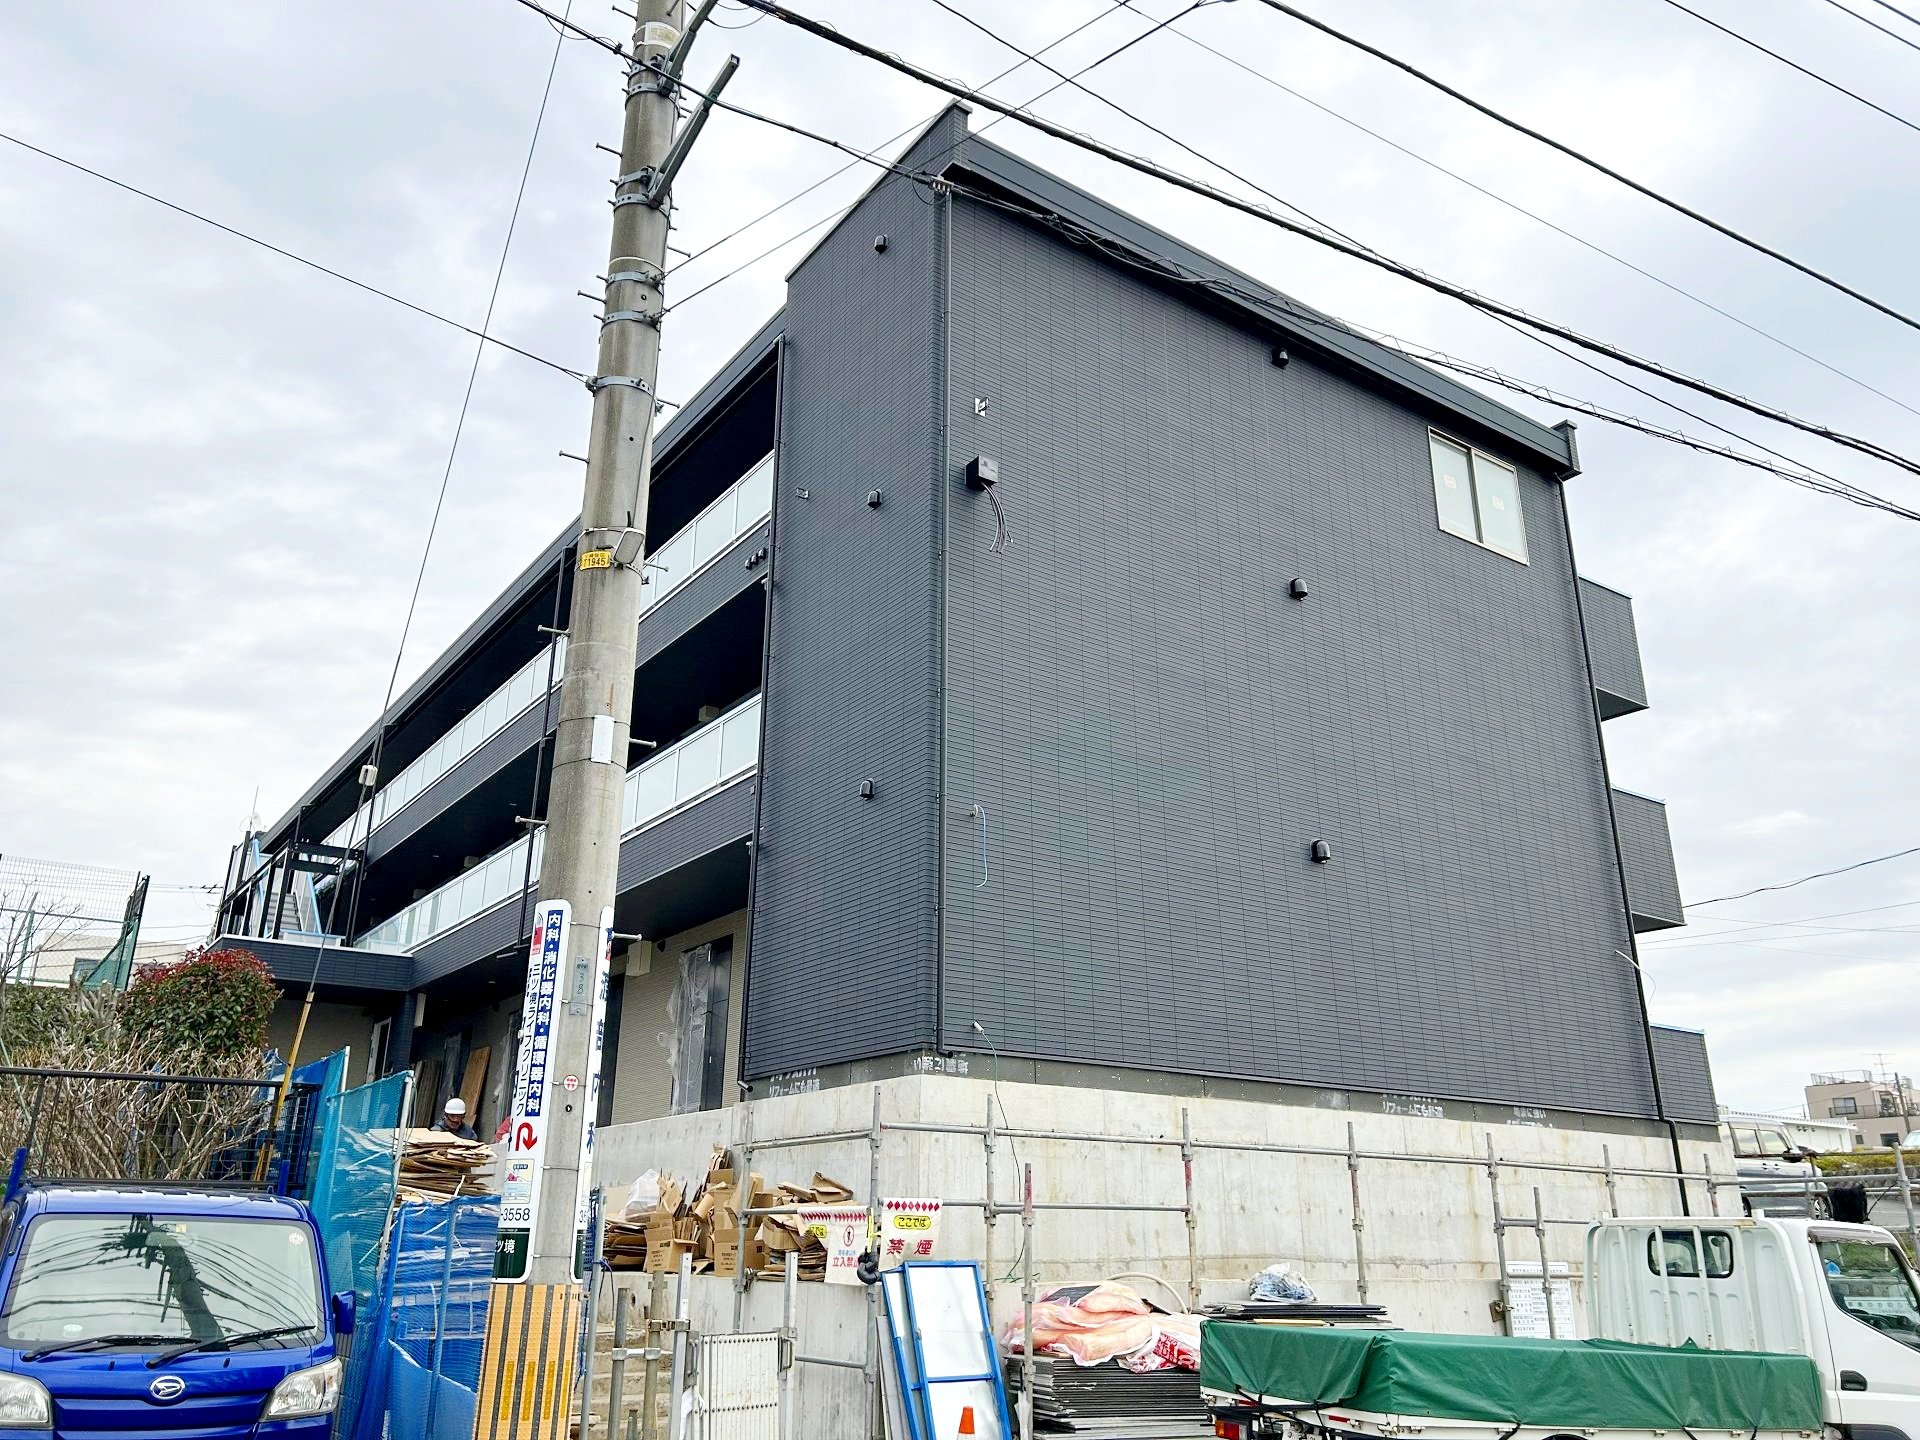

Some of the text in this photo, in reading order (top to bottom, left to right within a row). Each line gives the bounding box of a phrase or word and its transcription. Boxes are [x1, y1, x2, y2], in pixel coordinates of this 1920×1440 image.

[526, 913, 561, 1113] 内科・消化器内科・循環器内科
[898, 1217, 926, 1228] ここでは
[887, 1238, 934, 1255] 禁煙
